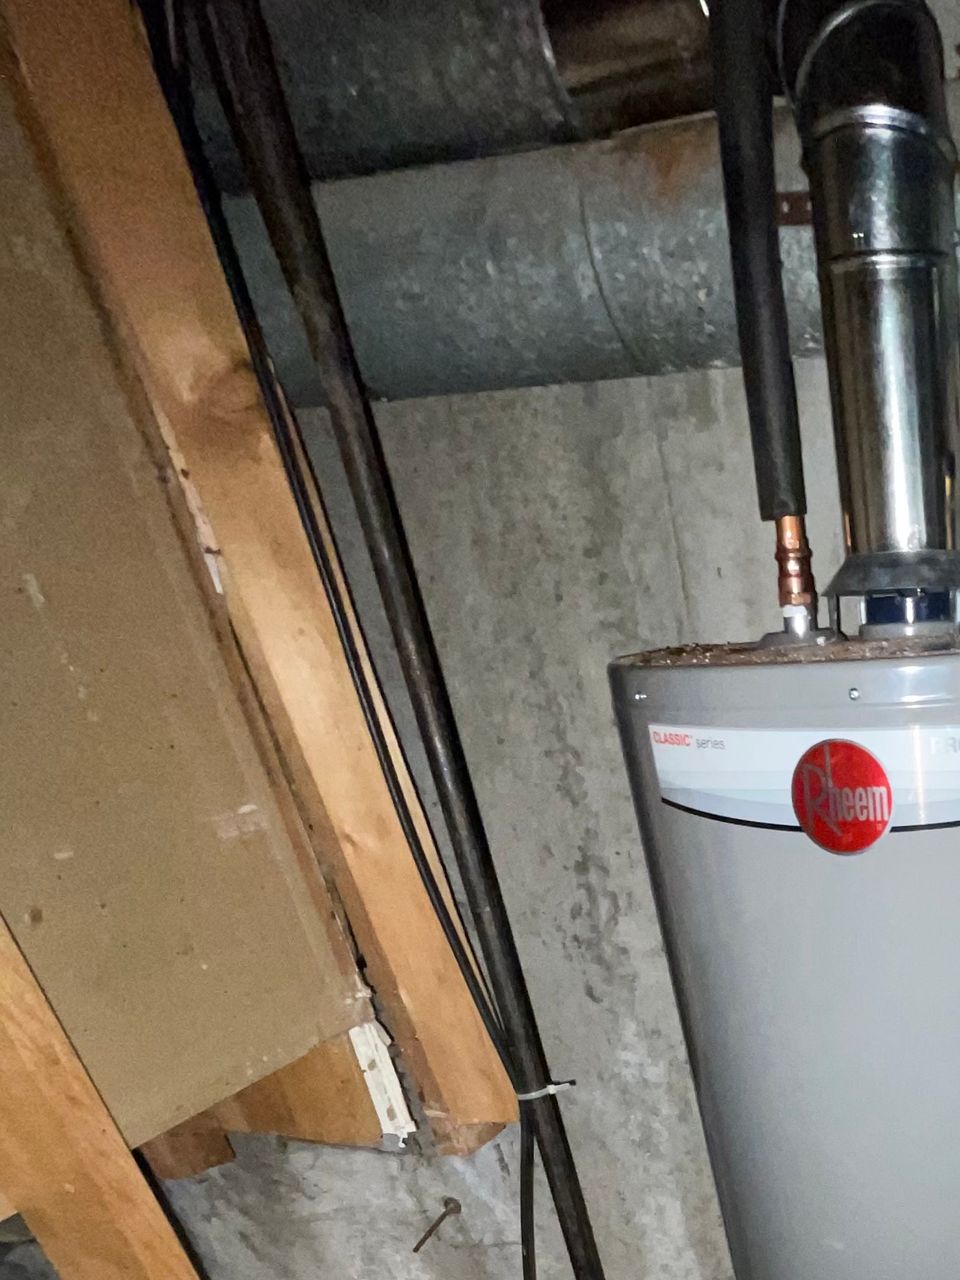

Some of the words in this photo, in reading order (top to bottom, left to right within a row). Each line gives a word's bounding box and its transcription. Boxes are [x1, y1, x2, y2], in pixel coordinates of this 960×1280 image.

[653, 731, 690, 747] CLASSIC
[695, 738, 726, 750] series
[800, 741, 889, 837] Rheem
